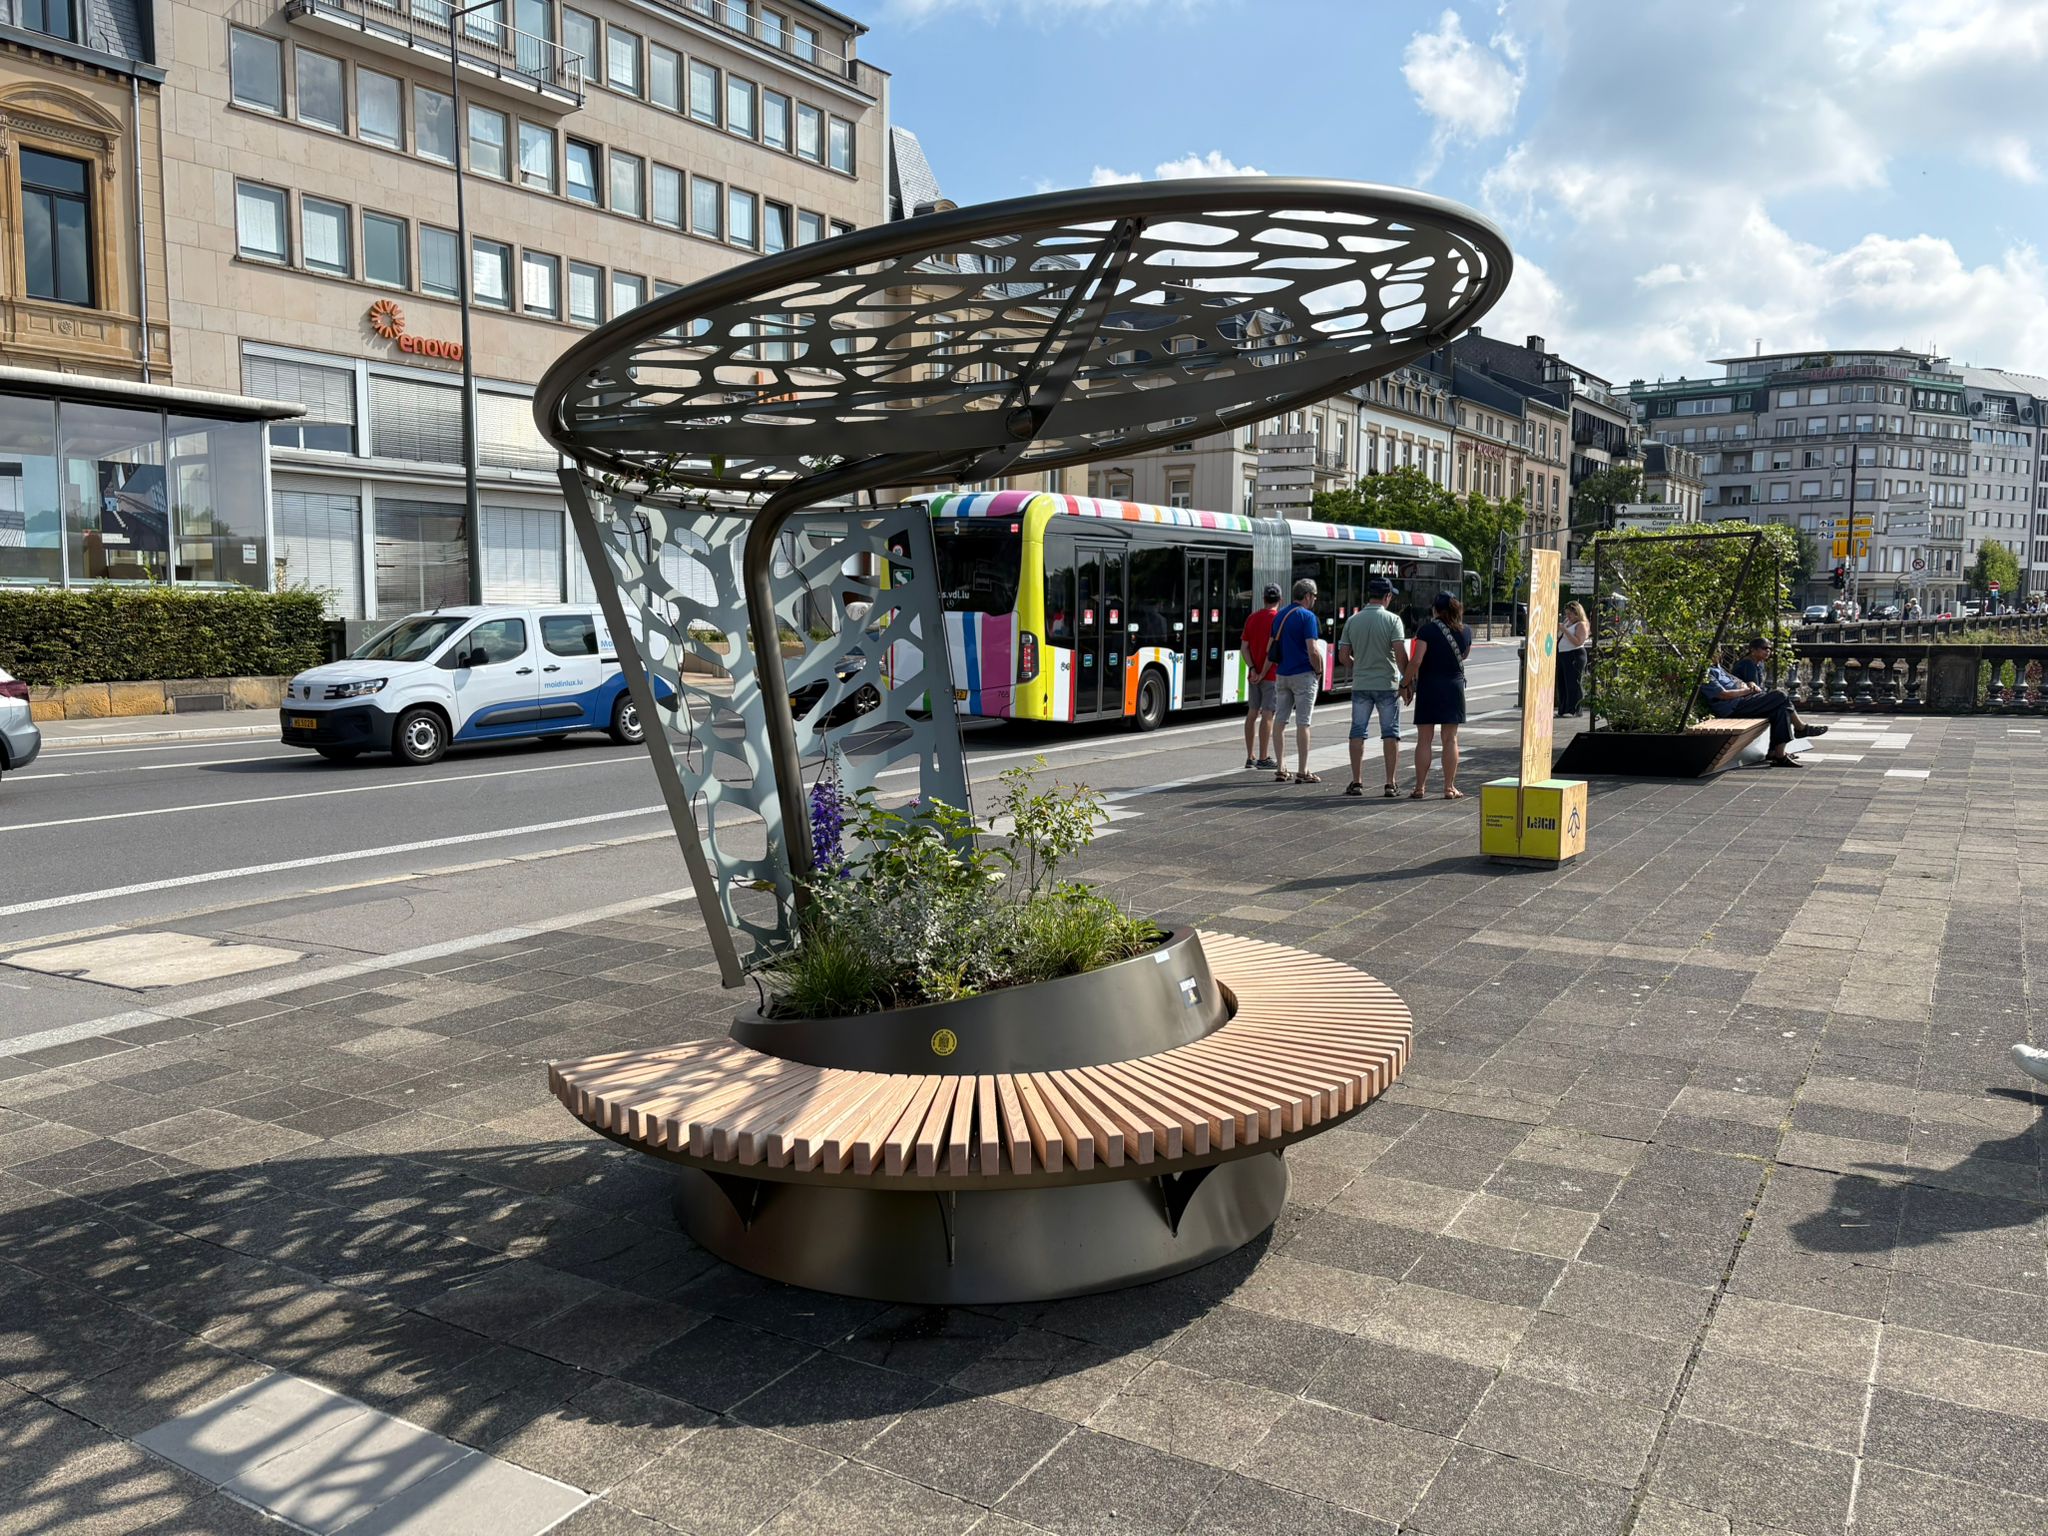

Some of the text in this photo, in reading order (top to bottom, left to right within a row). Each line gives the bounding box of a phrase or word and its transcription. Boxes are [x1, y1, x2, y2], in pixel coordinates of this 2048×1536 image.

[399, 333, 464, 361] enovo
[954, 520, 960, 536] 5
[1369, 560, 1399, 578] multiplicity
[938, 590, 970, 600] s.vdl.lu
[544, 679, 584, 689] moidinlux.lu
[1527, 816, 1556, 830] LUGA
